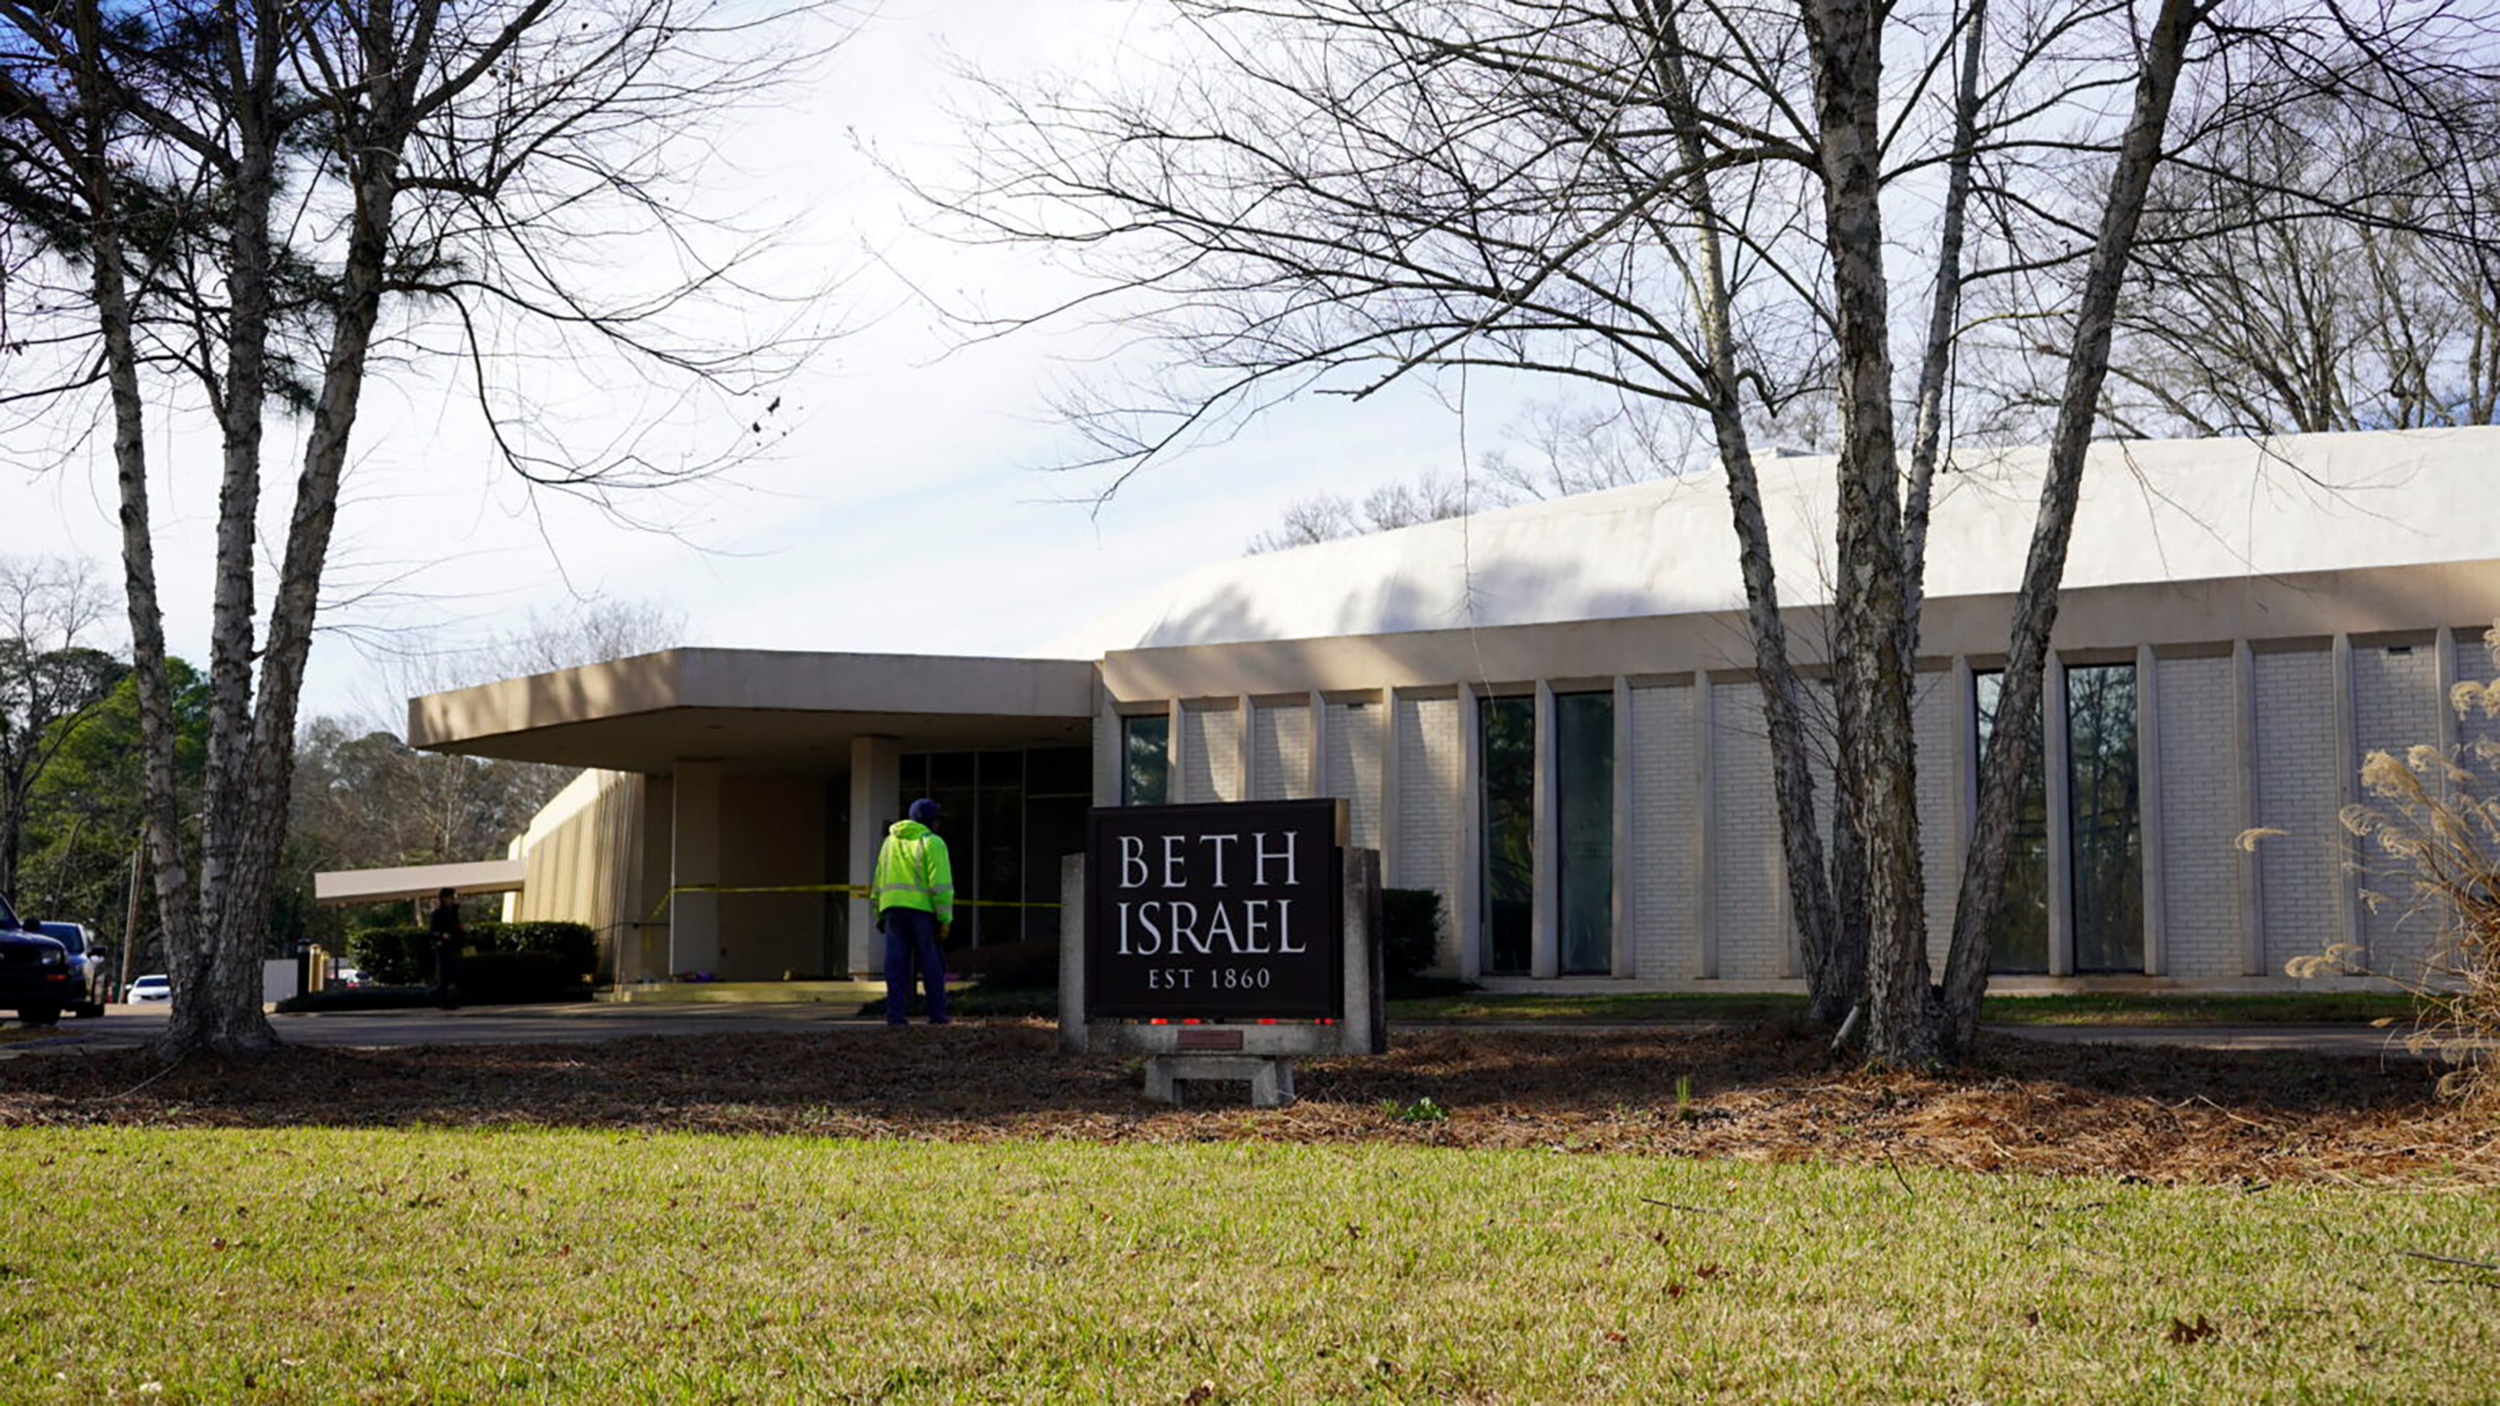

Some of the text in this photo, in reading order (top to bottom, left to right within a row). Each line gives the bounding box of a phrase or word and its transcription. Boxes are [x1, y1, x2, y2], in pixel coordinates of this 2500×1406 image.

[1118, 832, 1300, 888] BETH
[1117, 899, 1306, 955] ISRAEL
[1149, 967, 1270, 989] EST 1860
